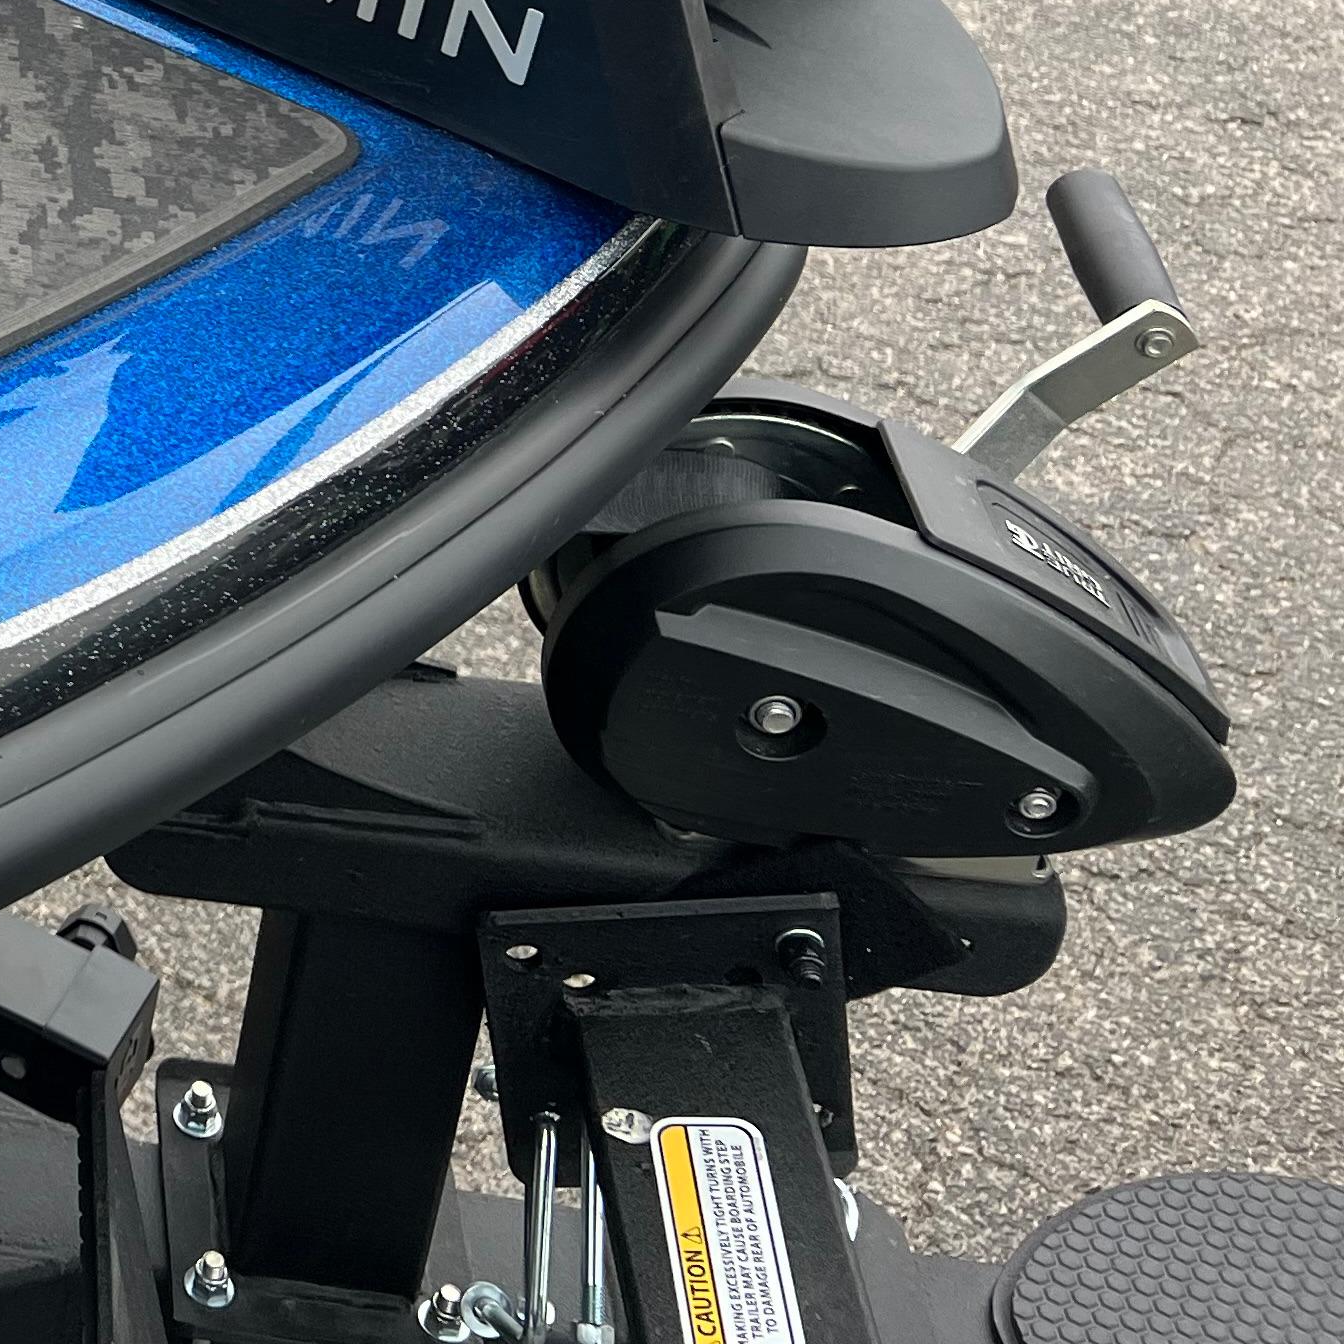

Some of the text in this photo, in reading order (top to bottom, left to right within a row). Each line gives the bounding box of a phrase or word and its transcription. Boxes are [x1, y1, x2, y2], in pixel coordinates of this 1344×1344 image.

[699, 1129, 714, 1156] WITH
[704, 1158, 720, 1193] TURNS
[711, 1195, 727, 1227] TIGHT
[715, 1140, 764, 1338] TRAILER MAY CAUSE BOARDING STEP
[731, 1145, 779, 1334] TO DAMAGE REAR OF AUTOMOBILE
[686, 1250, 716, 1337] CAUTION
[717, 1229, 741, 1300] EXCESSIVELY
